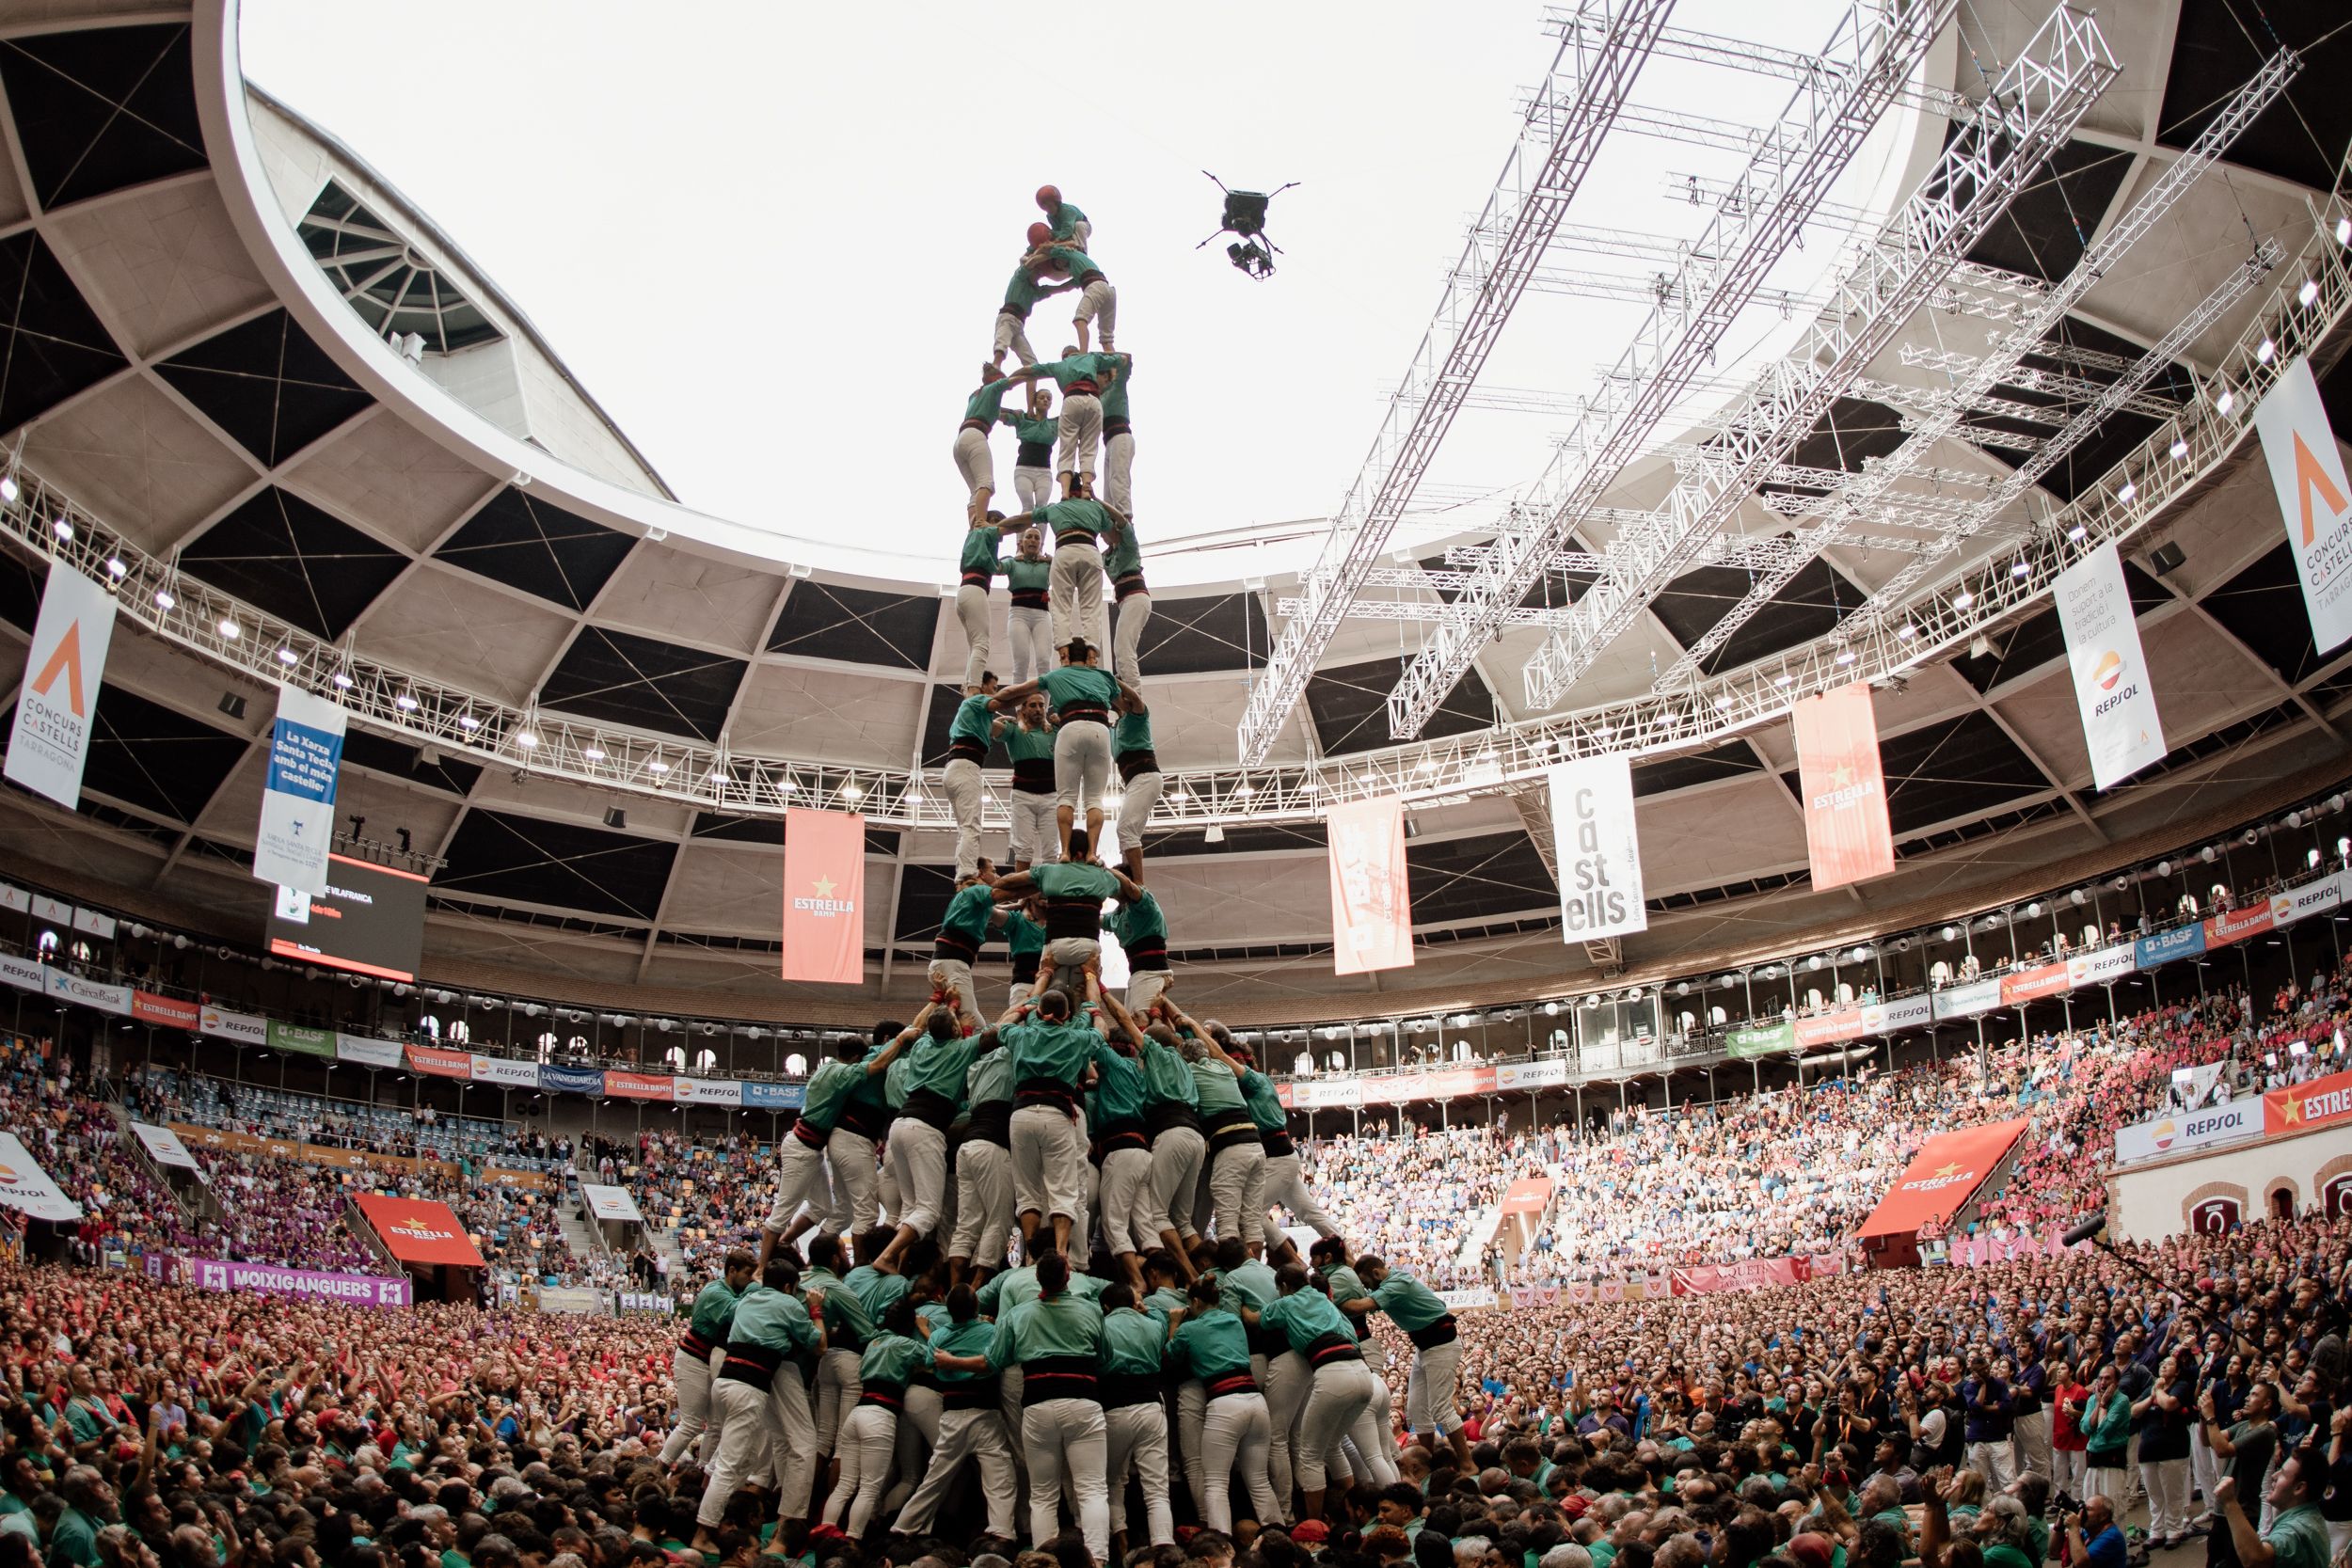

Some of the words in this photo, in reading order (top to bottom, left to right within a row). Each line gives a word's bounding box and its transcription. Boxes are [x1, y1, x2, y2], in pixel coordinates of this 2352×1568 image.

[2311, 541, 2352, 586] CASTELL
[2068, 578, 2096, 602] Donem
[2072, 593, 2097, 616] suport
[2098, 589, 2105, 599] a
[2105, 579, 2114, 594] la
[2317, 572, 2352, 610] TARRAG
[2075, 603, 2105, 630] tradició
[2078, 634, 2087, 645] la
[2088, 615, 2116, 640] cultura
[2095, 684, 2138, 717] REPSOL
[26, 698, 82, 736] CONCURS
[24, 713, 78, 752] CASTELLS
[286, 731, 299, 744] La
[301, 736, 330, 756] Xarxa
[20, 735, 75, 773] TARRAGONA
[276, 740, 307, 760] Santa
[308, 752, 336, 773] Tecla,
[274, 753, 297, 768] amb
[298, 762, 309, 773] el
[310, 768, 332, 783] món
[280, 768, 326, 793] casteller
[1813, 781, 1874, 810] ESTRELLA
[331, 886, 373, 904] VILAFRANCA
[794, 897, 854, 912] ESTRELLA
[2297, 884, 2340, 908] REPSOL
[2215, 922, 2249, 937] ESTRELLA
[2249, 911, 2272, 926] DAMM
[2161, 929, 2192, 948] BASF
[3, 963, 42, 982] REPSOL
[2094, 954, 2134, 971] REPSOL
[72, 982, 121, 1006] CaixaBank
[2011, 982, 2045, 993] ESTRELLA
[143, 1003, 177, 1019] ESTRELLA
[1888, 1006, 1930, 1022] REPSOL
[225, 1021, 265, 1036] REPSOL
[294, 1028, 326, 1042] BASF
[1754, 1028, 1784, 1041] BASF
[414, 1056, 448, 1069] ESTRELLA
[448, 1059, 469, 1070] DAMM
[497, 1067, 536, 1079] REPSOL
[542, 1071, 551, 1080] LA
[551, 1073, 602, 1085] VANGUARDIA
[1522, 1069, 1564, 1080] REPSOL
[616, 1082, 649, 1092] ESTRELLA
[649, 1084, 672, 1093] DAMM
[699, 1087, 741, 1098] REPSOL
[770, 1087, 800, 1097] BASF
[2303, 1087, 2352, 1121] ESTRE
[2185, 1112, 2243, 1138] REPSOL
[0, 1186, 49, 1196] EPSOL
[1900, 1171, 1974, 1191] ESTRELLA
[389, 1227, 453, 1239] ESTRELLA
[233, 1270, 372, 1298] MOIXIGANGUERS
